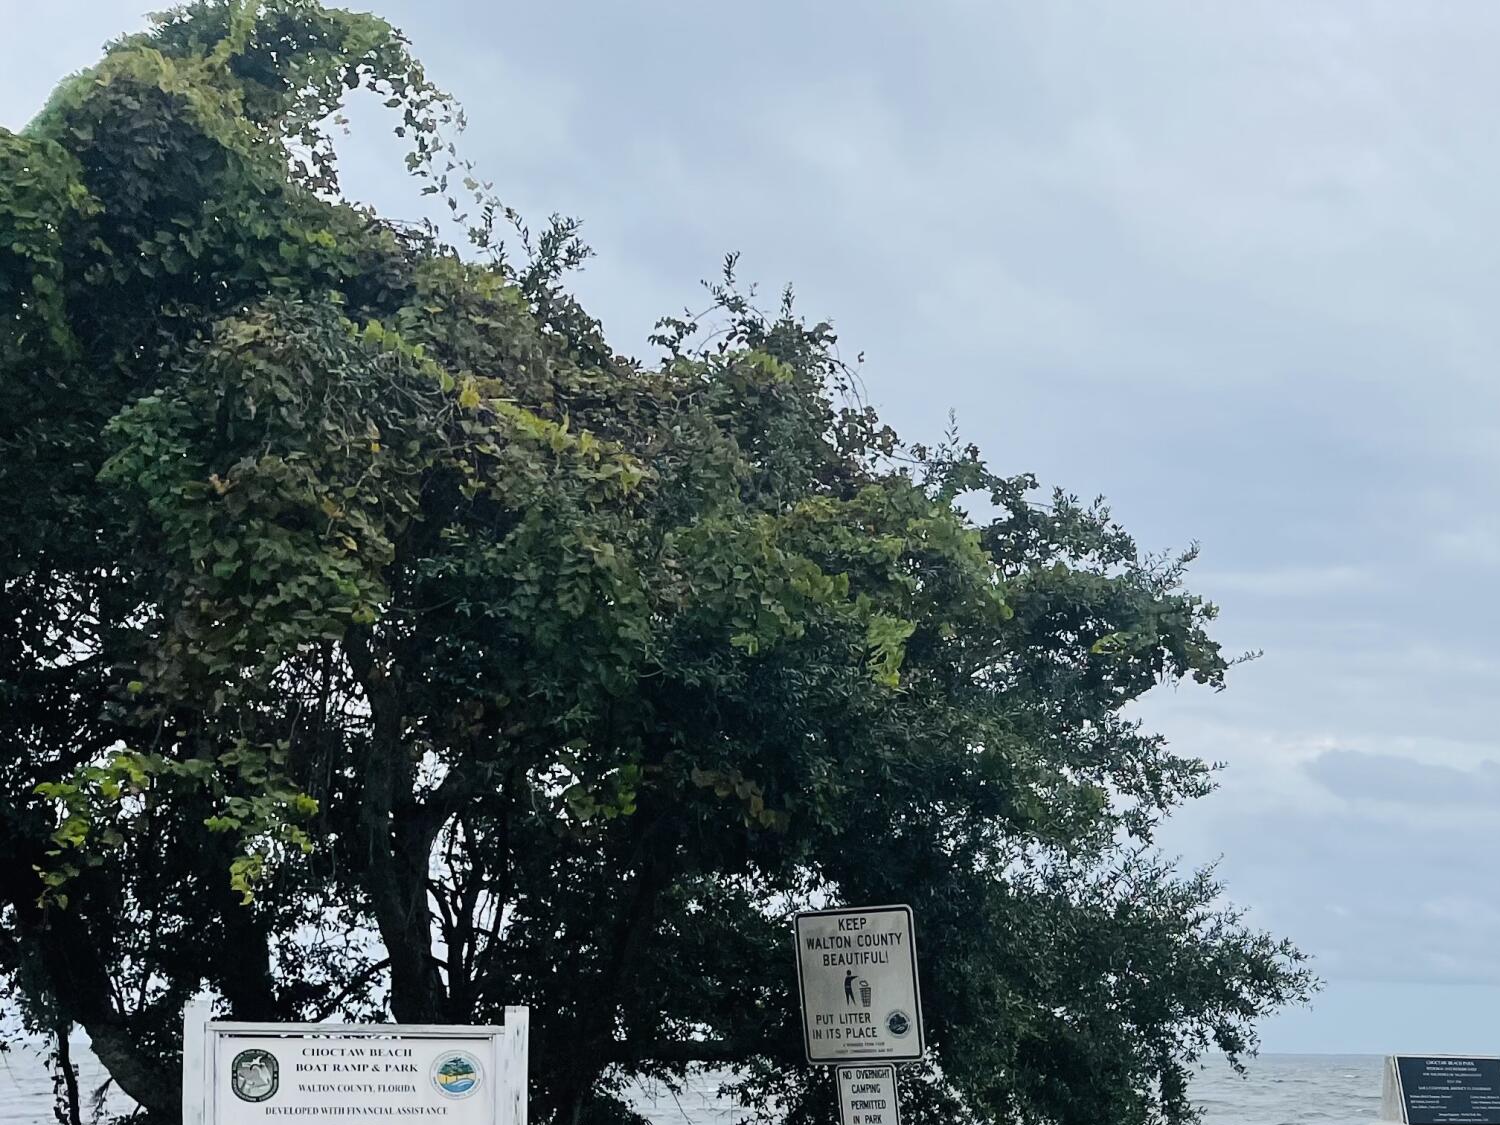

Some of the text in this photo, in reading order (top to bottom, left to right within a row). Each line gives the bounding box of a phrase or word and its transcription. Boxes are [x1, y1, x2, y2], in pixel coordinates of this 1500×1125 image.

[838, 917, 867, 931] KEEP
[806, 932, 902, 950] WALTON COUNTY
[822, 951, 889, 966] BEAUTIFUL!
[815, 1013, 871, 1025] PUT LITTER
[812, 1027, 878, 1040] IN ITS PLACE
[302, 1048, 412, 1057] CHOCTAW BEACH
[296, 1063, 418, 1072] BOAT RAMP & PARK
[843, 1069, 890, 1080] NO OVERNIGHT
[299, 1084, 416, 1093] WALTON COUNTY, FLORIDA
[851, 1083, 881, 1094] CAMPING
[851, 1099, 886, 1110] PERMITTED
[265, 1106, 448, 1115] DEVELOPED WITH FINANCIAL ASSISTANCE
[853, 1114, 882, 1124] IN PARK
